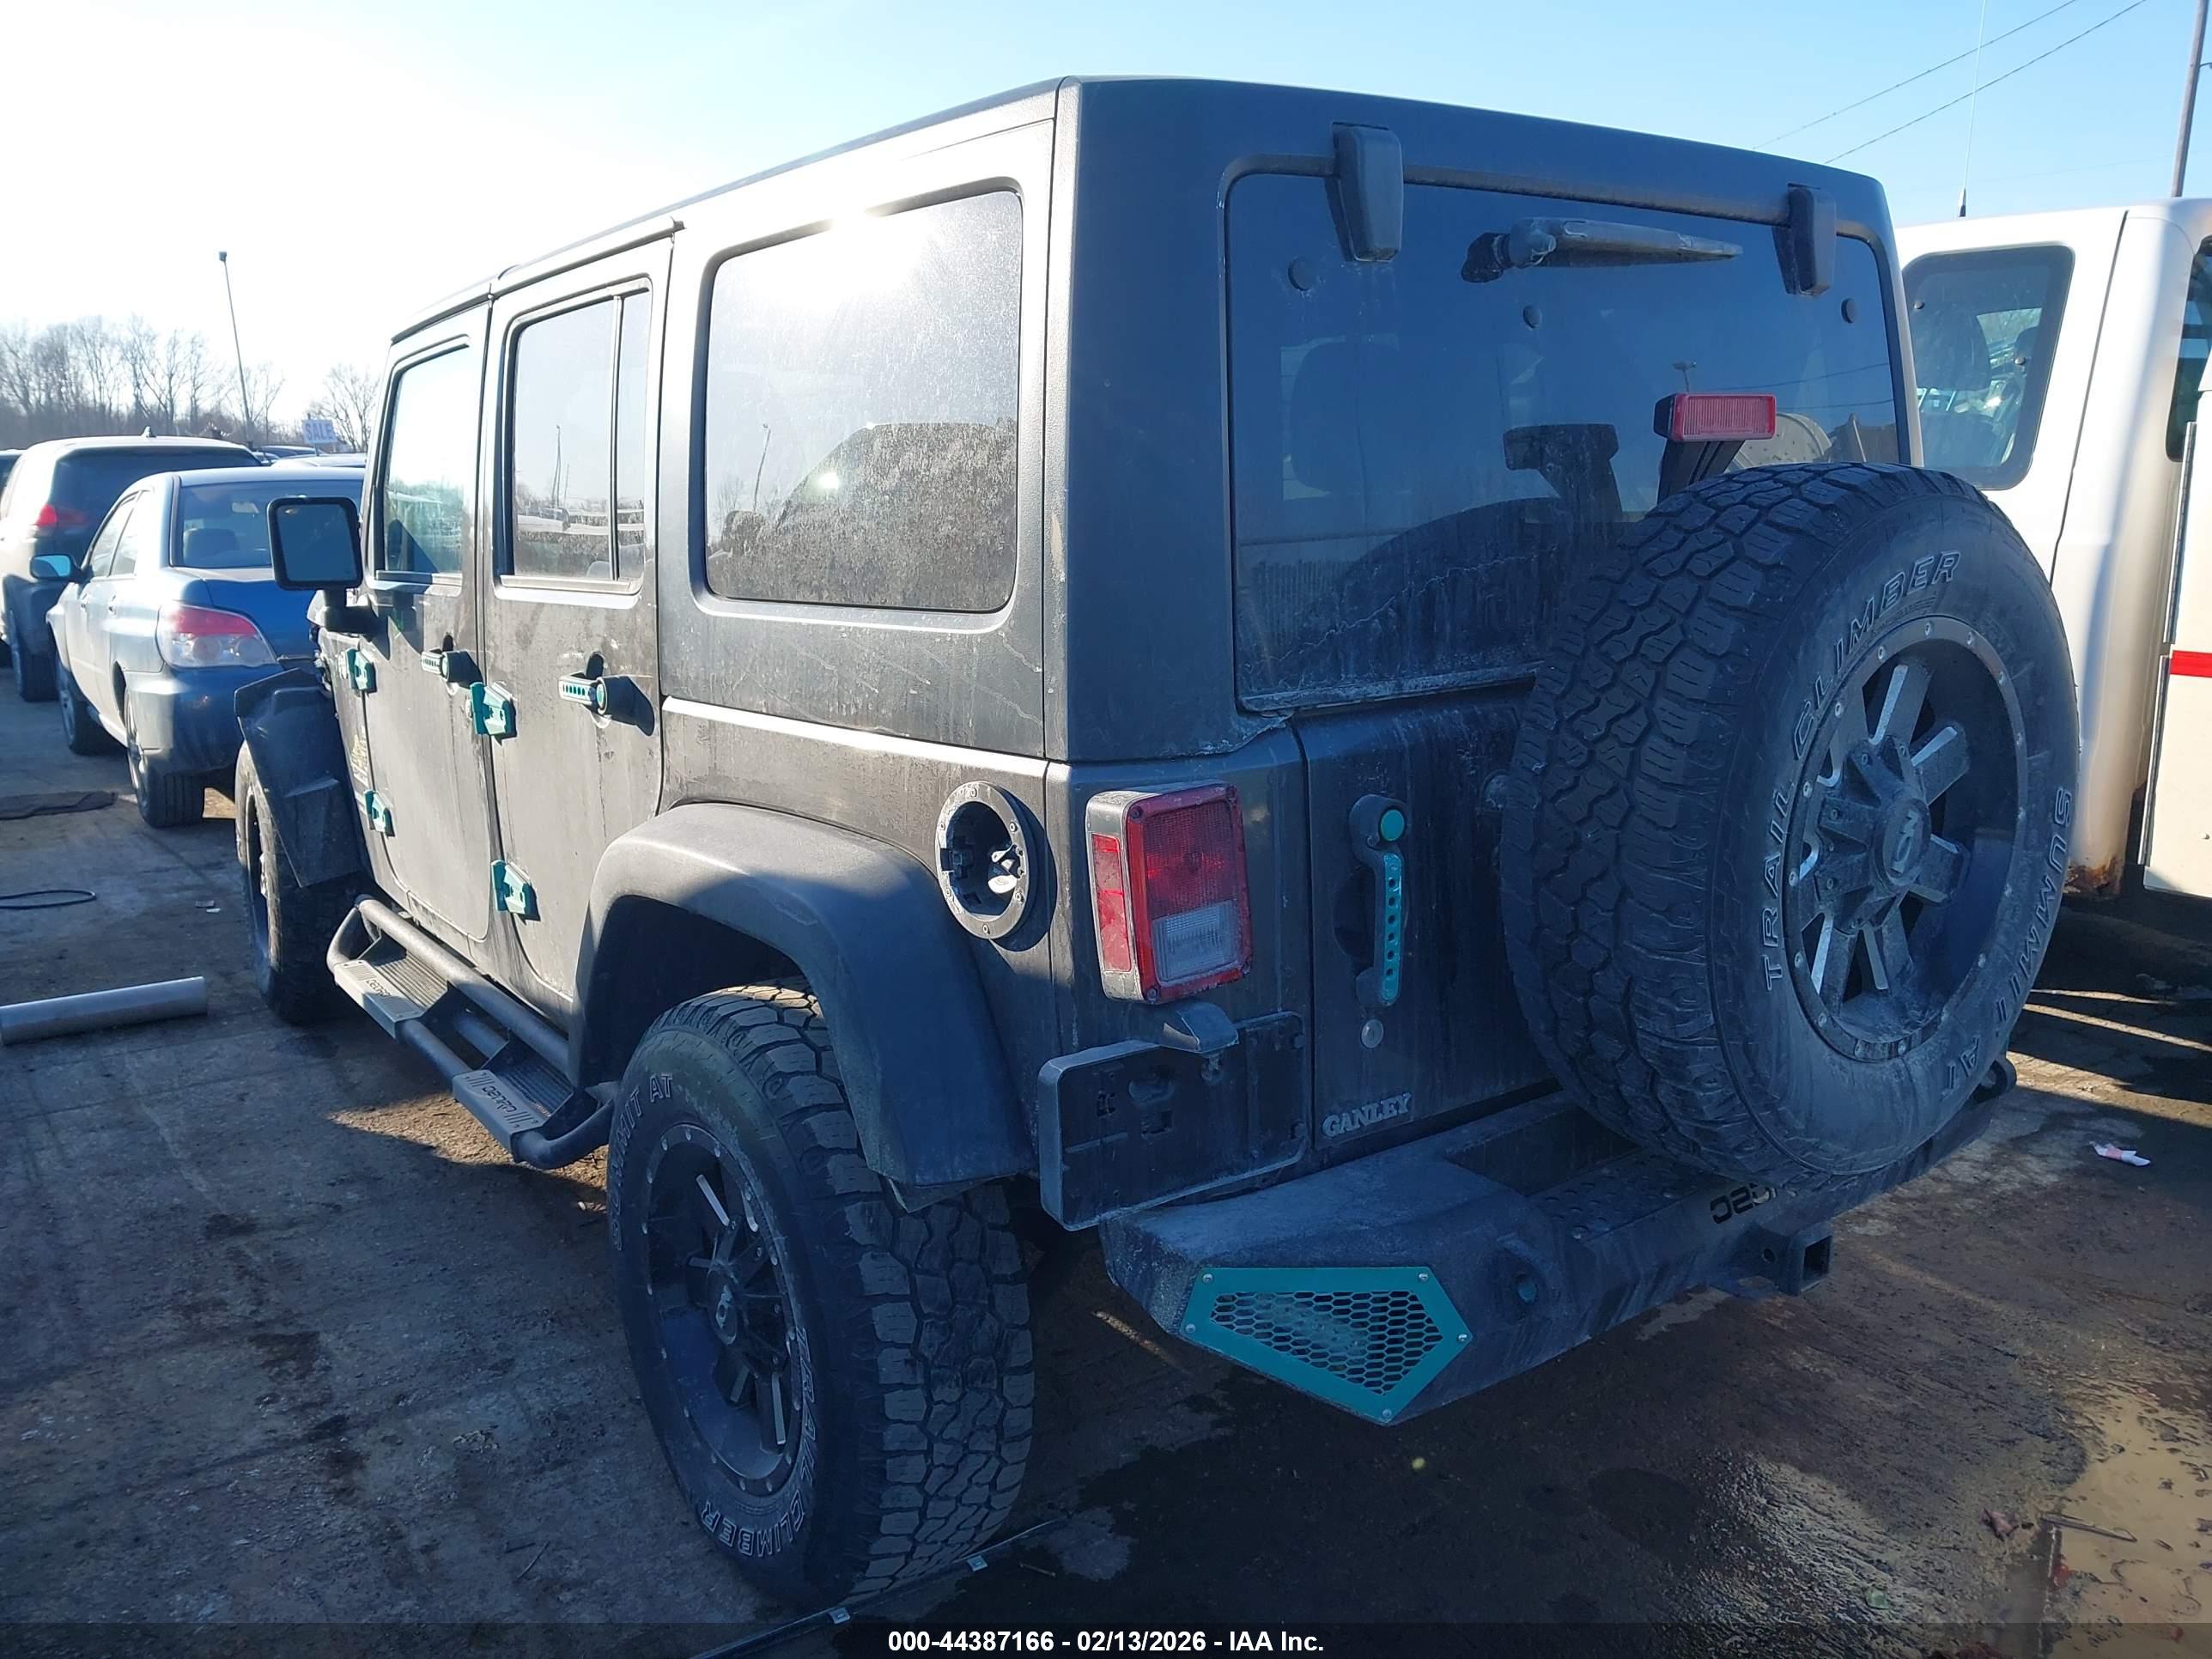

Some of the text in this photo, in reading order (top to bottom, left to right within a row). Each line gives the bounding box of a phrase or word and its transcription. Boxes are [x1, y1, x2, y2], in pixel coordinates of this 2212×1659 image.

[305, 422, 334, 440] SALE
[1762, 782, 1795, 991] TRAIL
[1794, 550, 1961, 760] CLIMBER
[649, 1073, 673, 1103] AT
[1322, 1091, 1413, 1138] GANLEY
[700, 1326, 816, 1558] TRAIL CLIMBER
